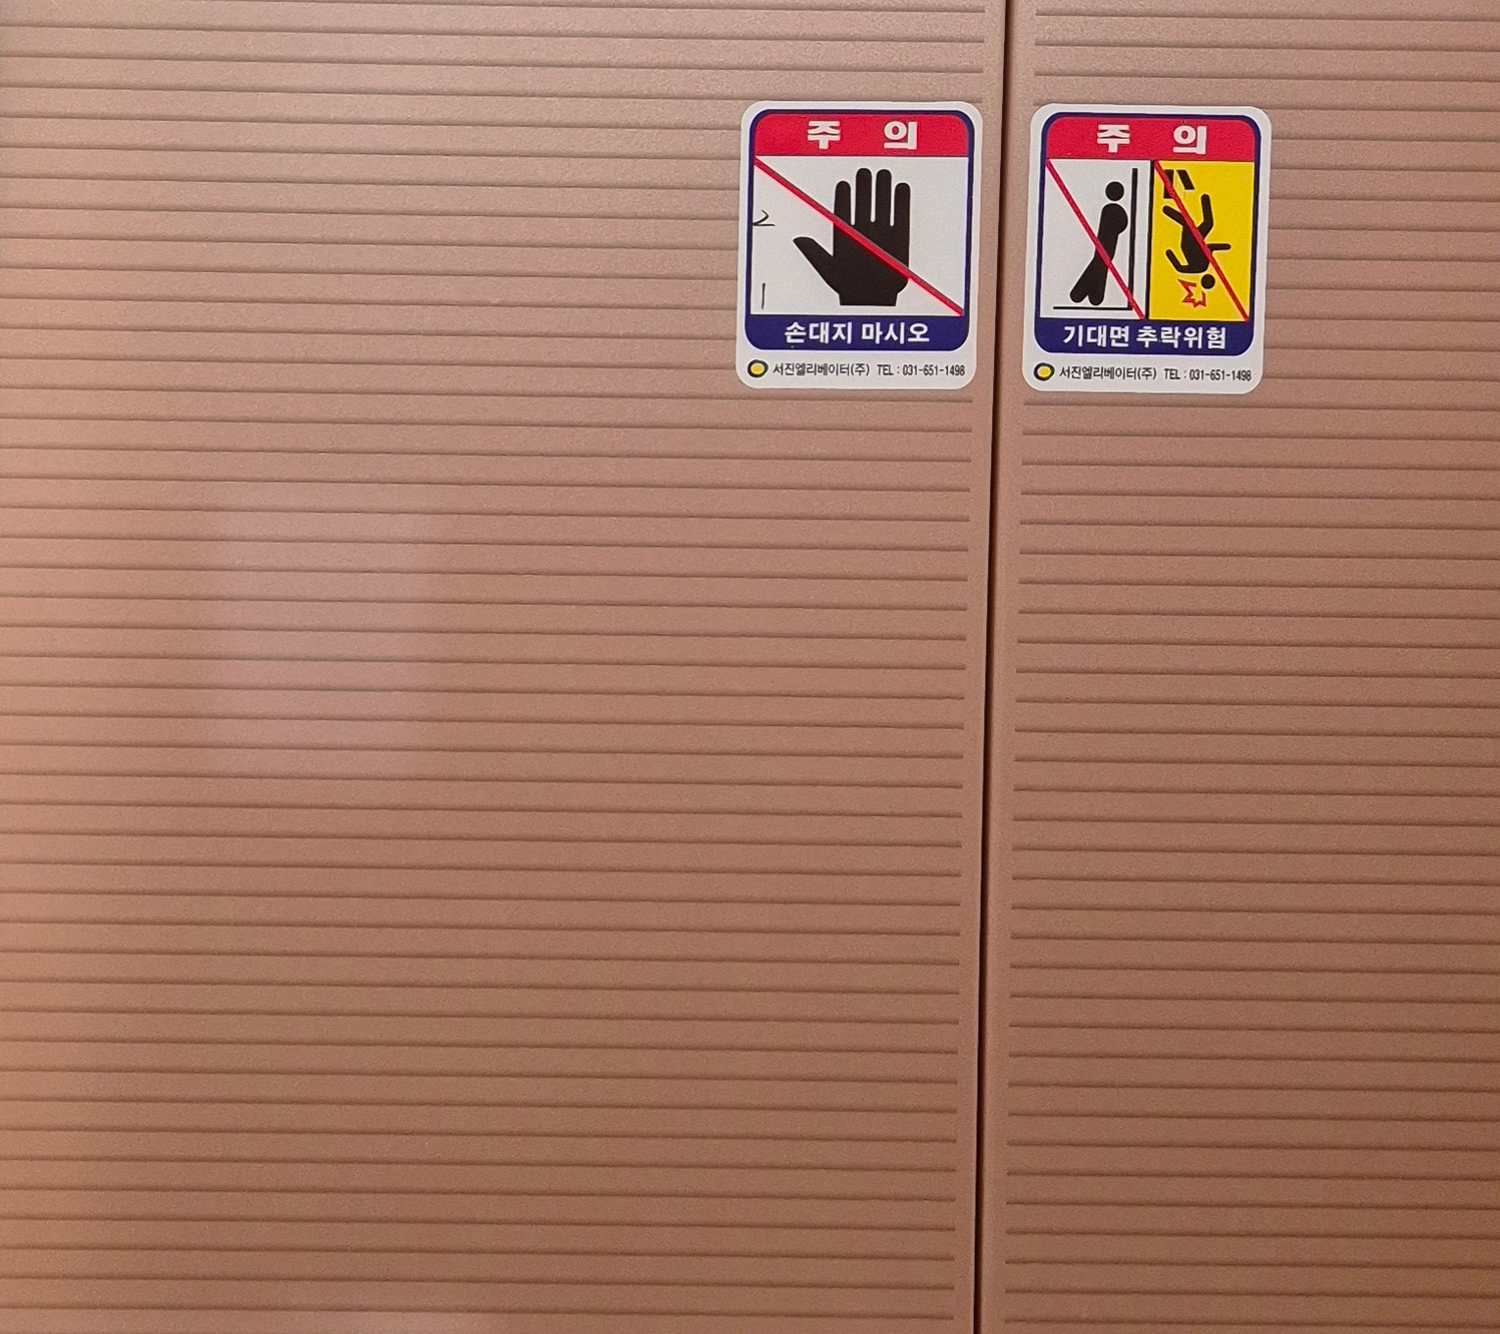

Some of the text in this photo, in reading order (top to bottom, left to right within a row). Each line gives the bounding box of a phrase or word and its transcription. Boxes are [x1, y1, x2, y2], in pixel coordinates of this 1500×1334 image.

[784, 321, 931, 345] 손대지 마시오
[1063, 324, 1227, 350] 기대면 추락위험
[902, 364, 966, 376] 031-651-1498
[1189, 368, 1252, 381] 031-651-1498
